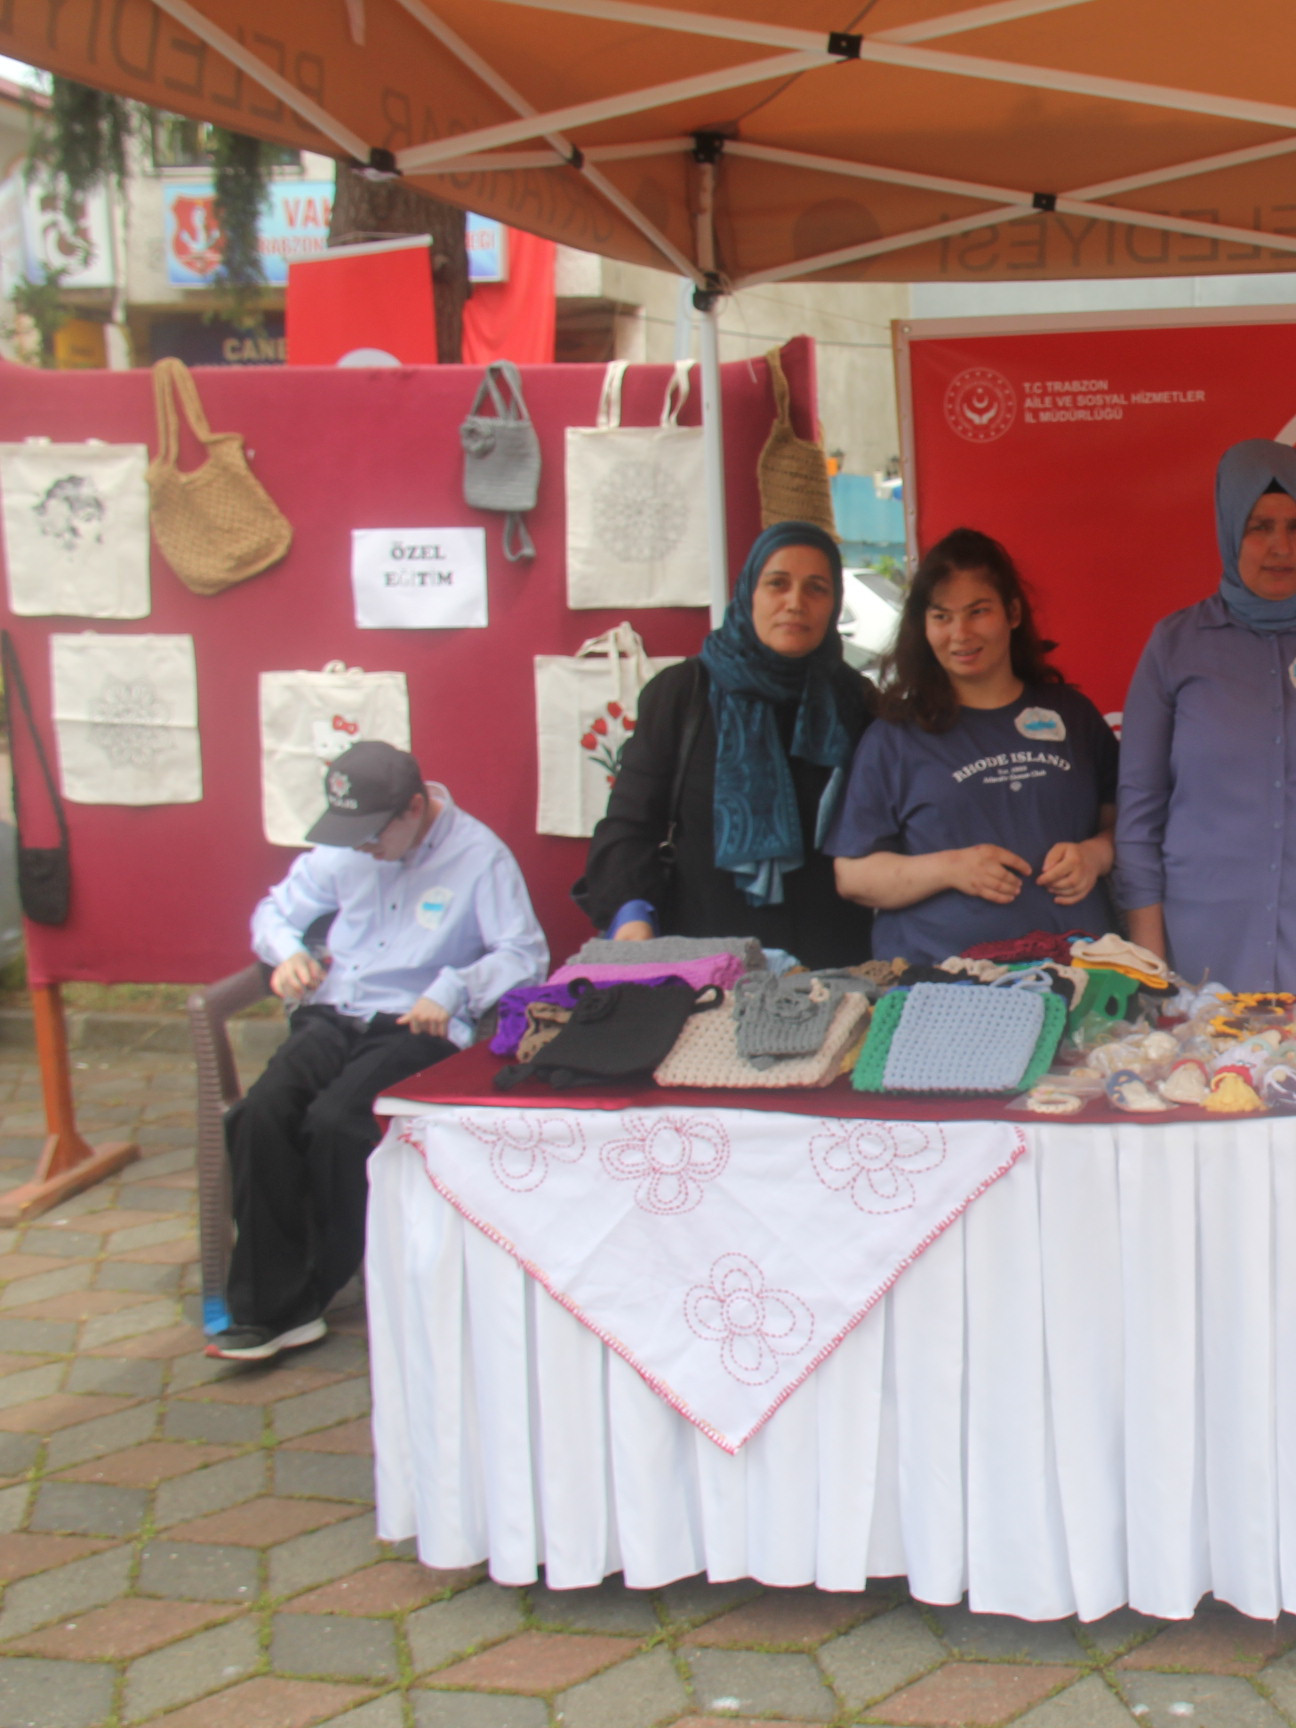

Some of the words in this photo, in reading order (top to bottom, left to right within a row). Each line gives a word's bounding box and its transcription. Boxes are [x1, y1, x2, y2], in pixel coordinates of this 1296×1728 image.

[1046, 380, 1109, 393] TRABZON
[1024, 395, 1053, 409] AİLE
[1056, 395, 1074, 407] VE
[1076, 393, 1128, 406] SOSYAL
[1131, 390, 1206, 404] HİZMETLER
[1039, 407, 1123, 423] MÜDÜRLÜĞÜ
[391, 541, 446, 560] ÖZEL
[385, 569, 453, 588] EĞİTİM
[952, 753, 1009, 783] RHODE
[1010, 751, 1071, 771] ISLAND
